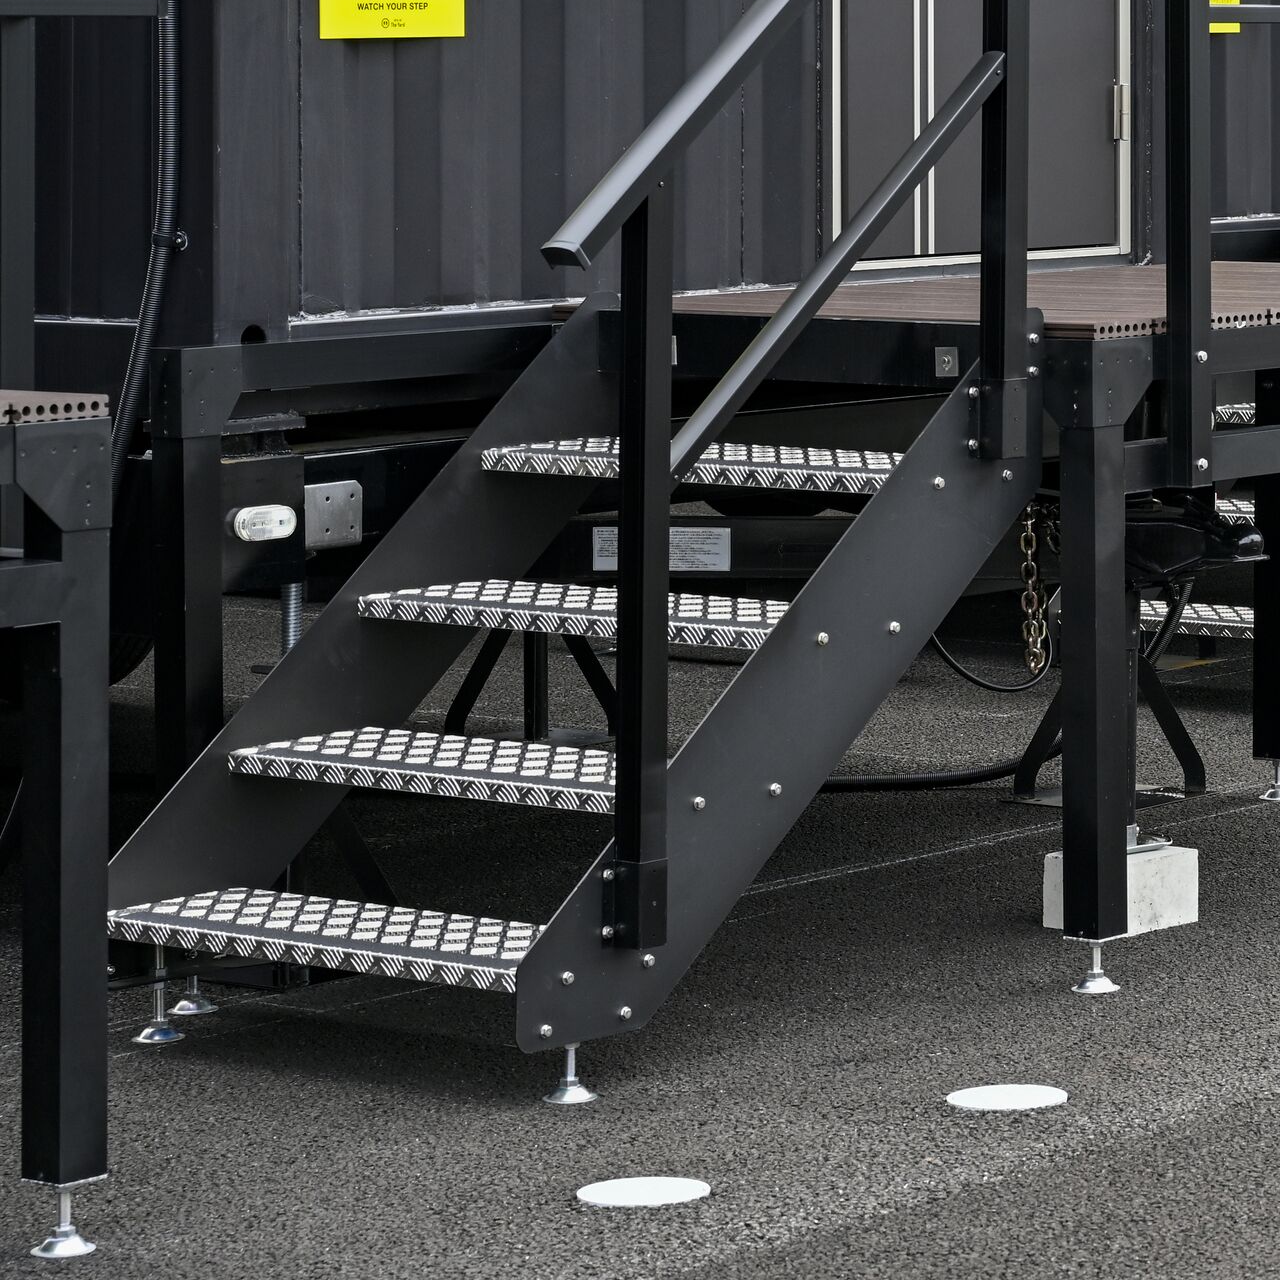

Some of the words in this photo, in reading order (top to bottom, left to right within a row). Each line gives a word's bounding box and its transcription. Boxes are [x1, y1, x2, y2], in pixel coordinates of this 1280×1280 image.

[357, 2, 384, 11] WATCH
[386, 2, 407, 11] YOUR
[409, 2, 428, 10] STEP
